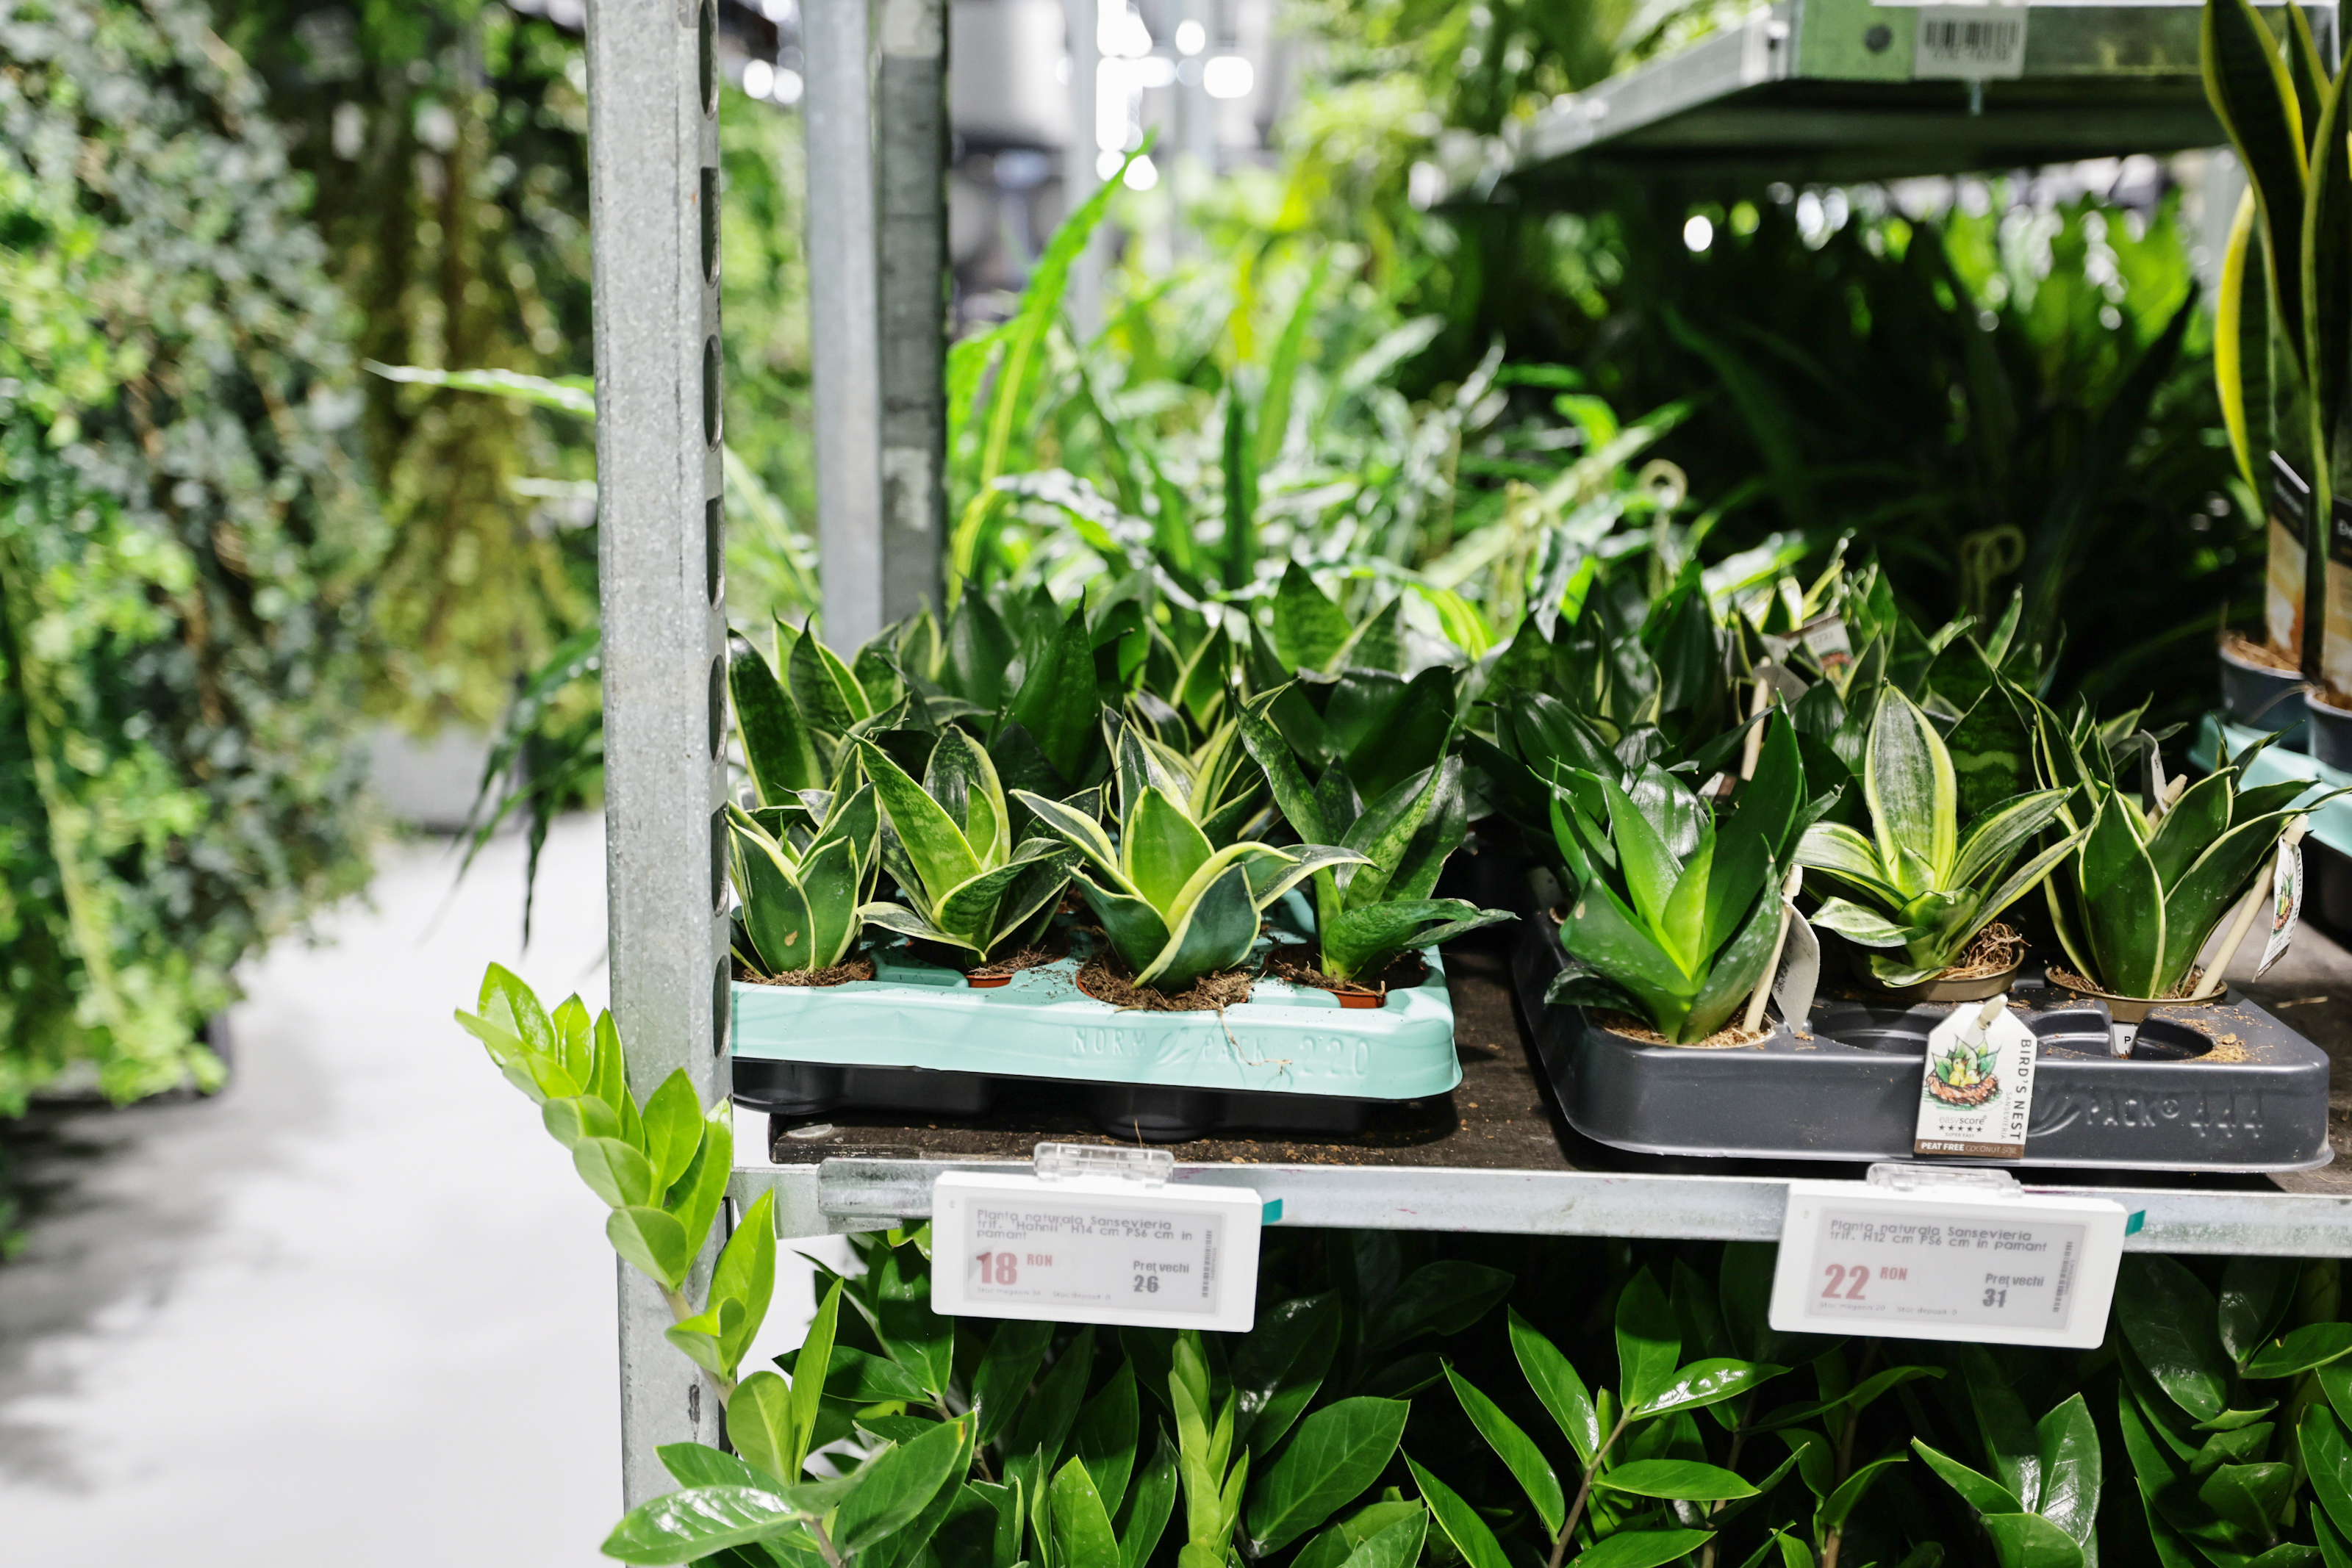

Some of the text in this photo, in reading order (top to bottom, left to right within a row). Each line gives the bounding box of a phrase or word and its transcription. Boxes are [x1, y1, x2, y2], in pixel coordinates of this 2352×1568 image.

[1074, 1028, 1371, 1079] NORM PACK 220
[2009, 1038, 2032, 1140] BIRD'S NEST
[2001, 1092, 2012, 1140] SANSEVIERIA
[1921, 1142, 2018, 1155] PEAT FREE COCONUT SOIL
[978, 1209, 1172, 1231] Planta naturala Sansevieria
[977, 1229, 1027, 1240] pamant
[1071, 1224, 1093, 1234] H14
[1100, 1228, 1119, 1237] cm
[1154, 1231, 1174, 1240] cm
[1181, 1231, 1192, 1241] in
[1831, 1220, 2032, 1241] Planta naturala Sansevieria
[1863, 1231, 1886, 1242] H12
[1893, 1235, 1913, 1244] cm
[1948, 1238, 1970, 1248] cm
[1976, 1238, 1988, 1248] in
[1994, 1241, 2048, 1252] pamant
[976, 1251, 1018, 1286] 18
[1026, 1253, 1053, 1267] RON
[1159, 1263, 1190, 1273] vechi
[1821, 1264, 1871, 1301] 22
[1879, 1266, 1908, 1281] RON
[2012, 1276, 2045, 1287] vechi
[1133, 1275, 1160, 1293] 26
[1982, 1288, 2007, 1308] 31
